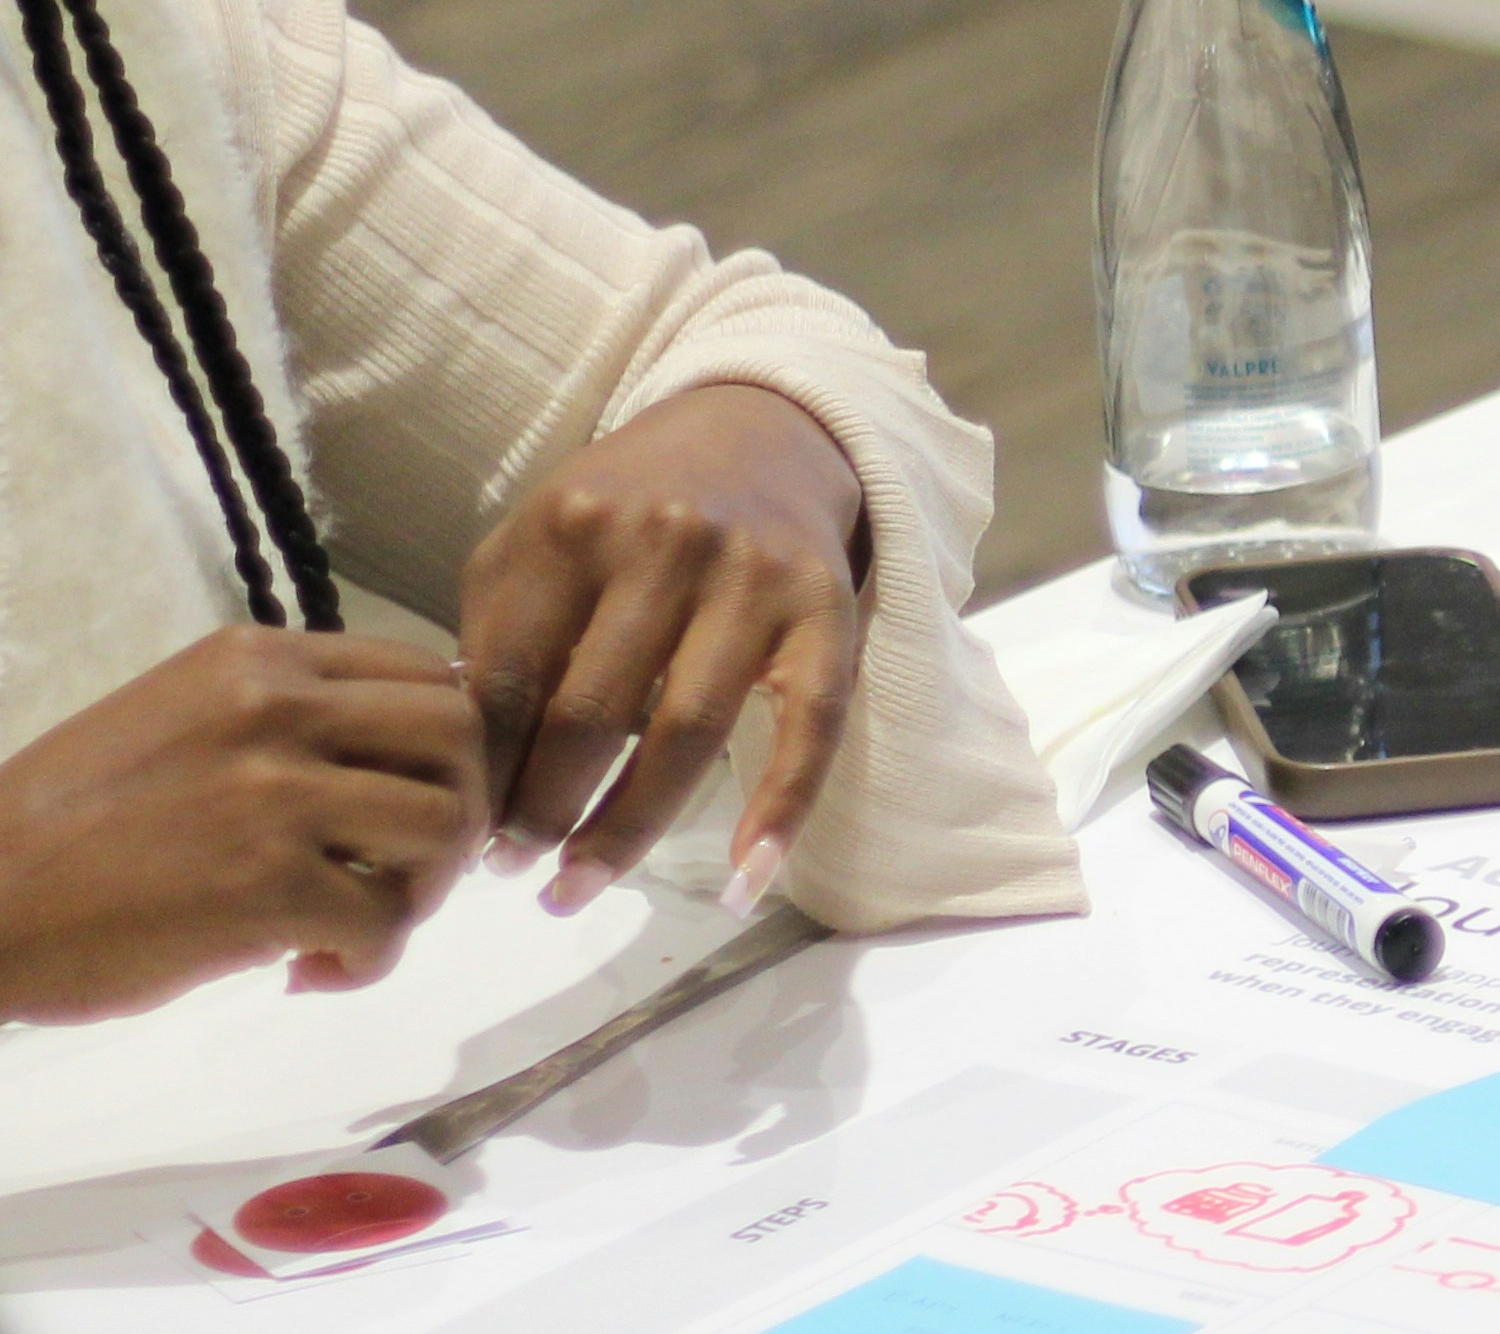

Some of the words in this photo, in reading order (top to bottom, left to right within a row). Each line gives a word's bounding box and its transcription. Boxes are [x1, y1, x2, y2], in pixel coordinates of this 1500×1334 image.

[1232, 839, 1292, 896] PENFLEX
[1207, 969, 1307, 999] when
[1309, 991, 1397, 1017] they
[1056, 1028, 1200, 1065] STAGES
[728, 1194, 832, 1245] STEPS
